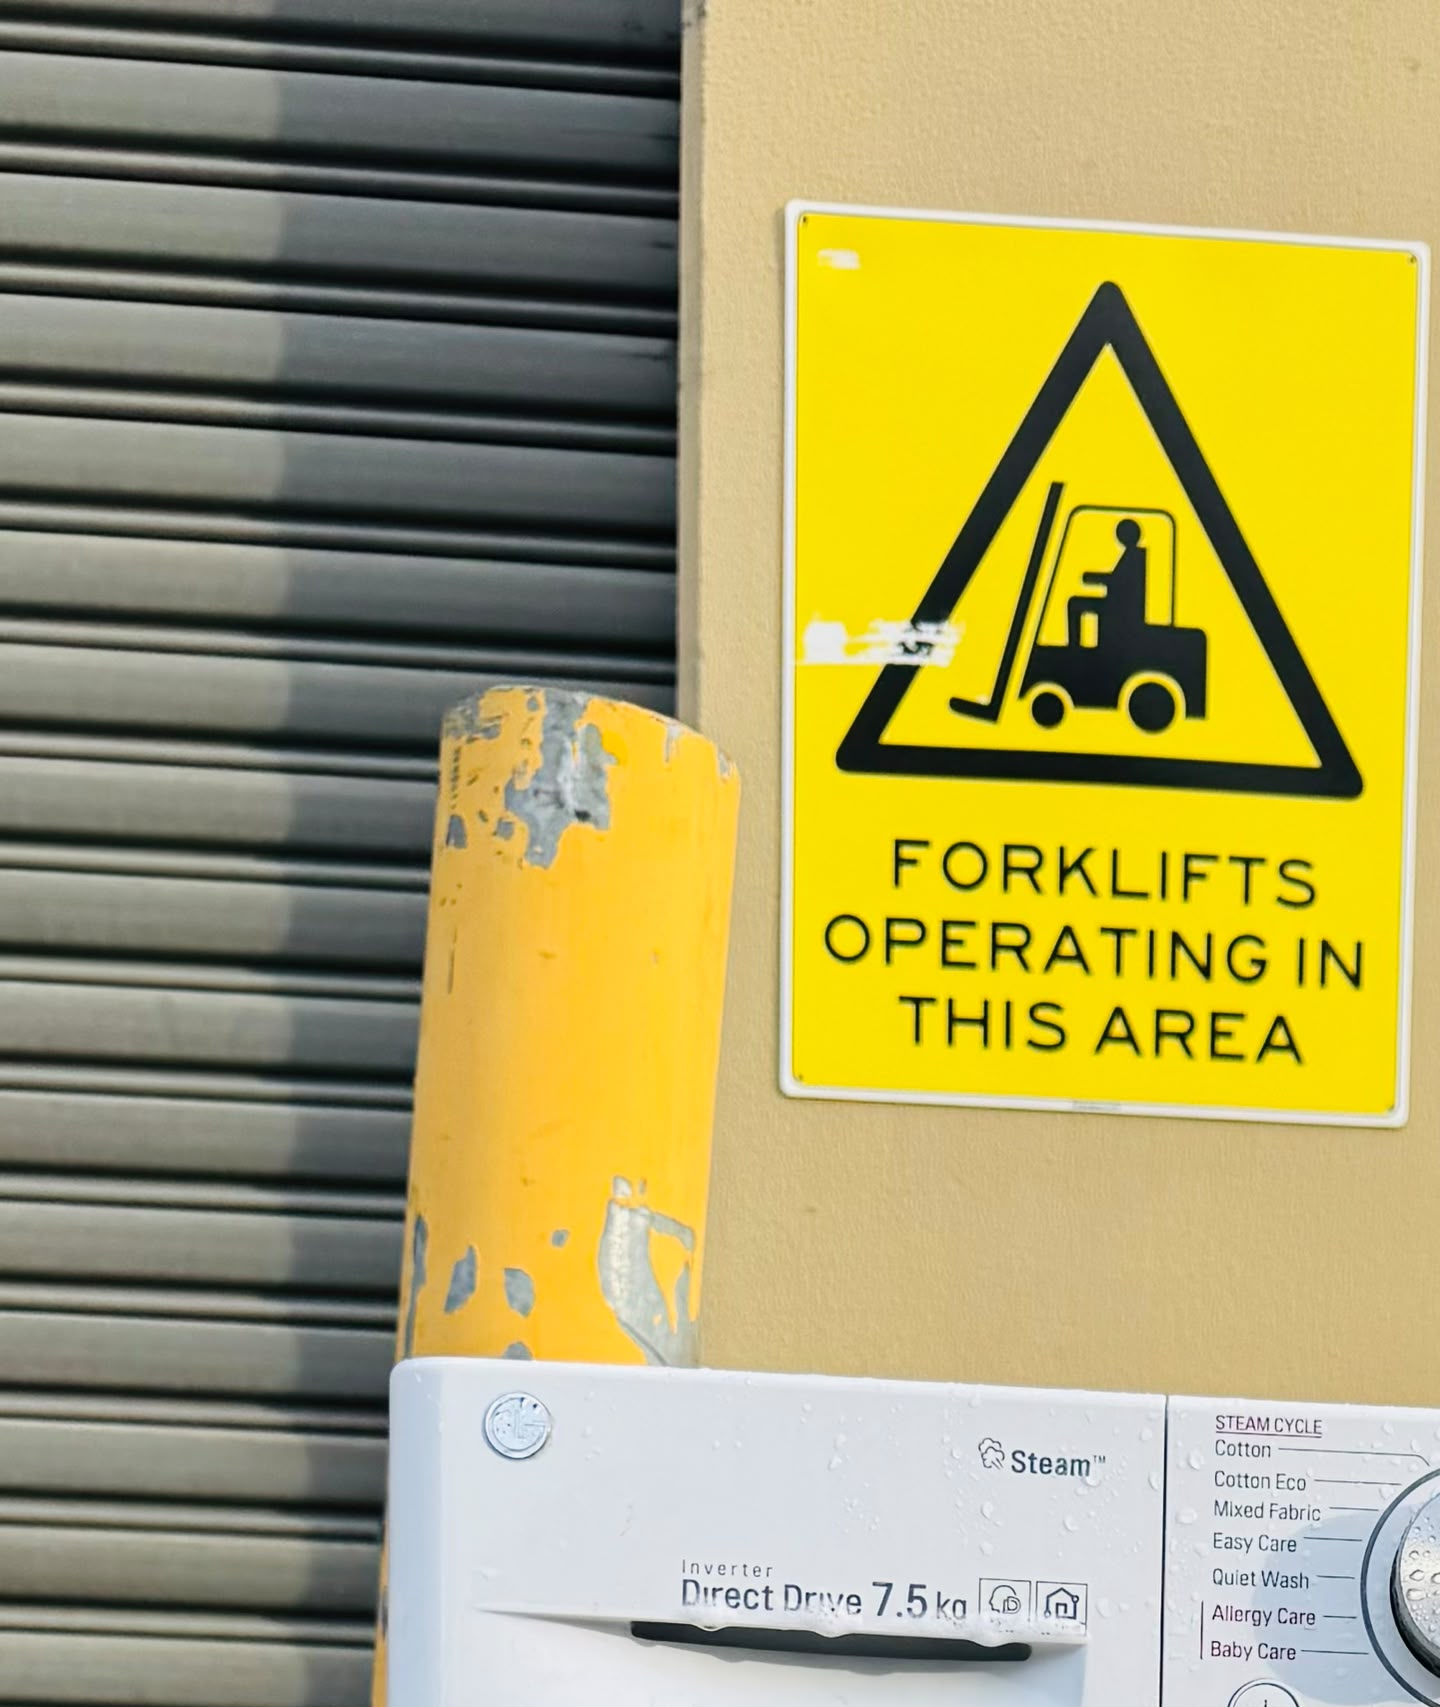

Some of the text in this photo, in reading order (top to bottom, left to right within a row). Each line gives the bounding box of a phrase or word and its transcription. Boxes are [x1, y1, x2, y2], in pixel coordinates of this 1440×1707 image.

[892, 839, 1316, 909] FORKLIFTS
[823, 912, 1365, 989] OPERATING IN
[899, 995, 1304, 1065] THIS AREA
[1215, 1414, 1323, 1434] STEAM CYCLE
[1215, 1439, 1271, 1458] Cotton
[1214, 1470, 1307, 1491] Cotton Eco
[1213, 1499, 1321, 1521] Mixed Fabric
[1213, 1532, 1297, 1554] Easy Care
[682, 1560, 774, 1578] Inverter
[1212, 1568, 1310, 1589] Quiet Wash
[681, 1579, 774, 1612] Direct
[783, 1585, 862, 1617] Drive
[871, 1581, 929, 1619] 7.5
[1212, 1604, 1316, 1627] Allergy Care
[1210, 1640, 1296, 1661] Baby Care
